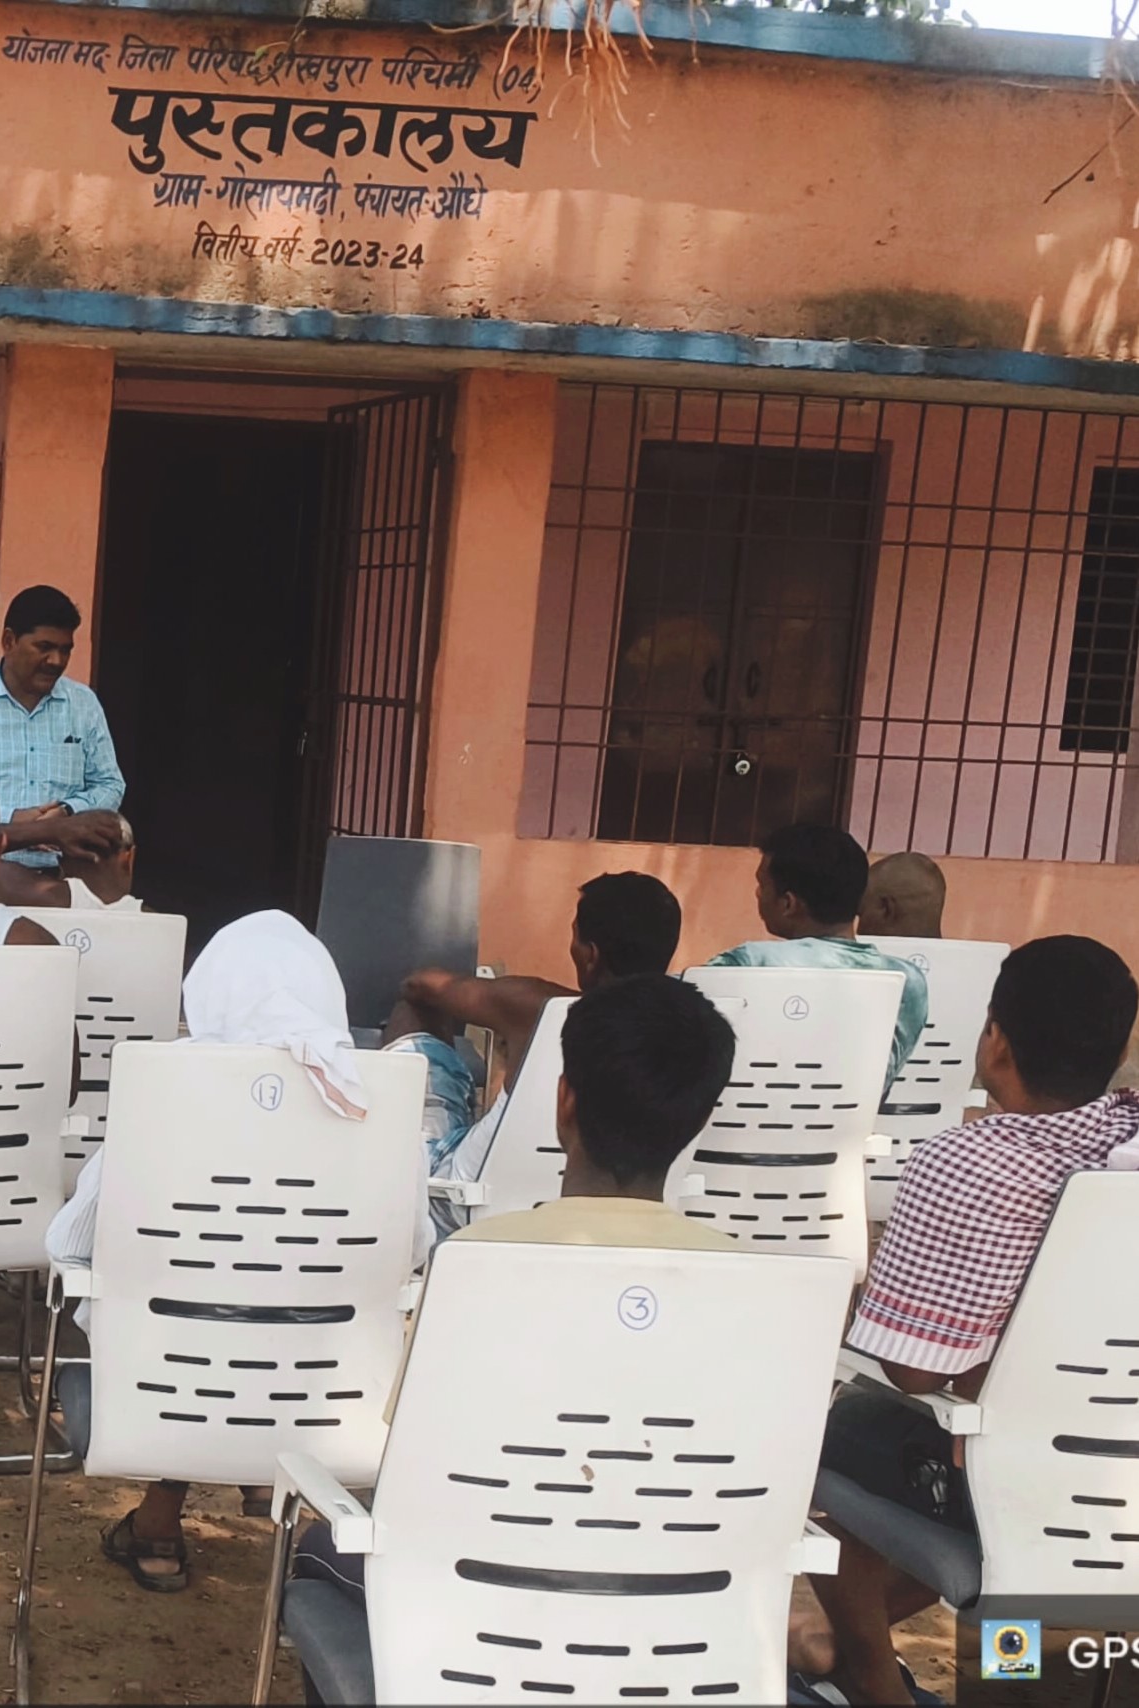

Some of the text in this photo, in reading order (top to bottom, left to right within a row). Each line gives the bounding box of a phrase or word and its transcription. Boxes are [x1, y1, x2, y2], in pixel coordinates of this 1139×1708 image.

[2, 27, 74, 65] योजना
[117, 33, 180, 73] जिला
[107, 86, 538, 175] पुस्तकालय
[311, 238, 424, 269] 2023-24
